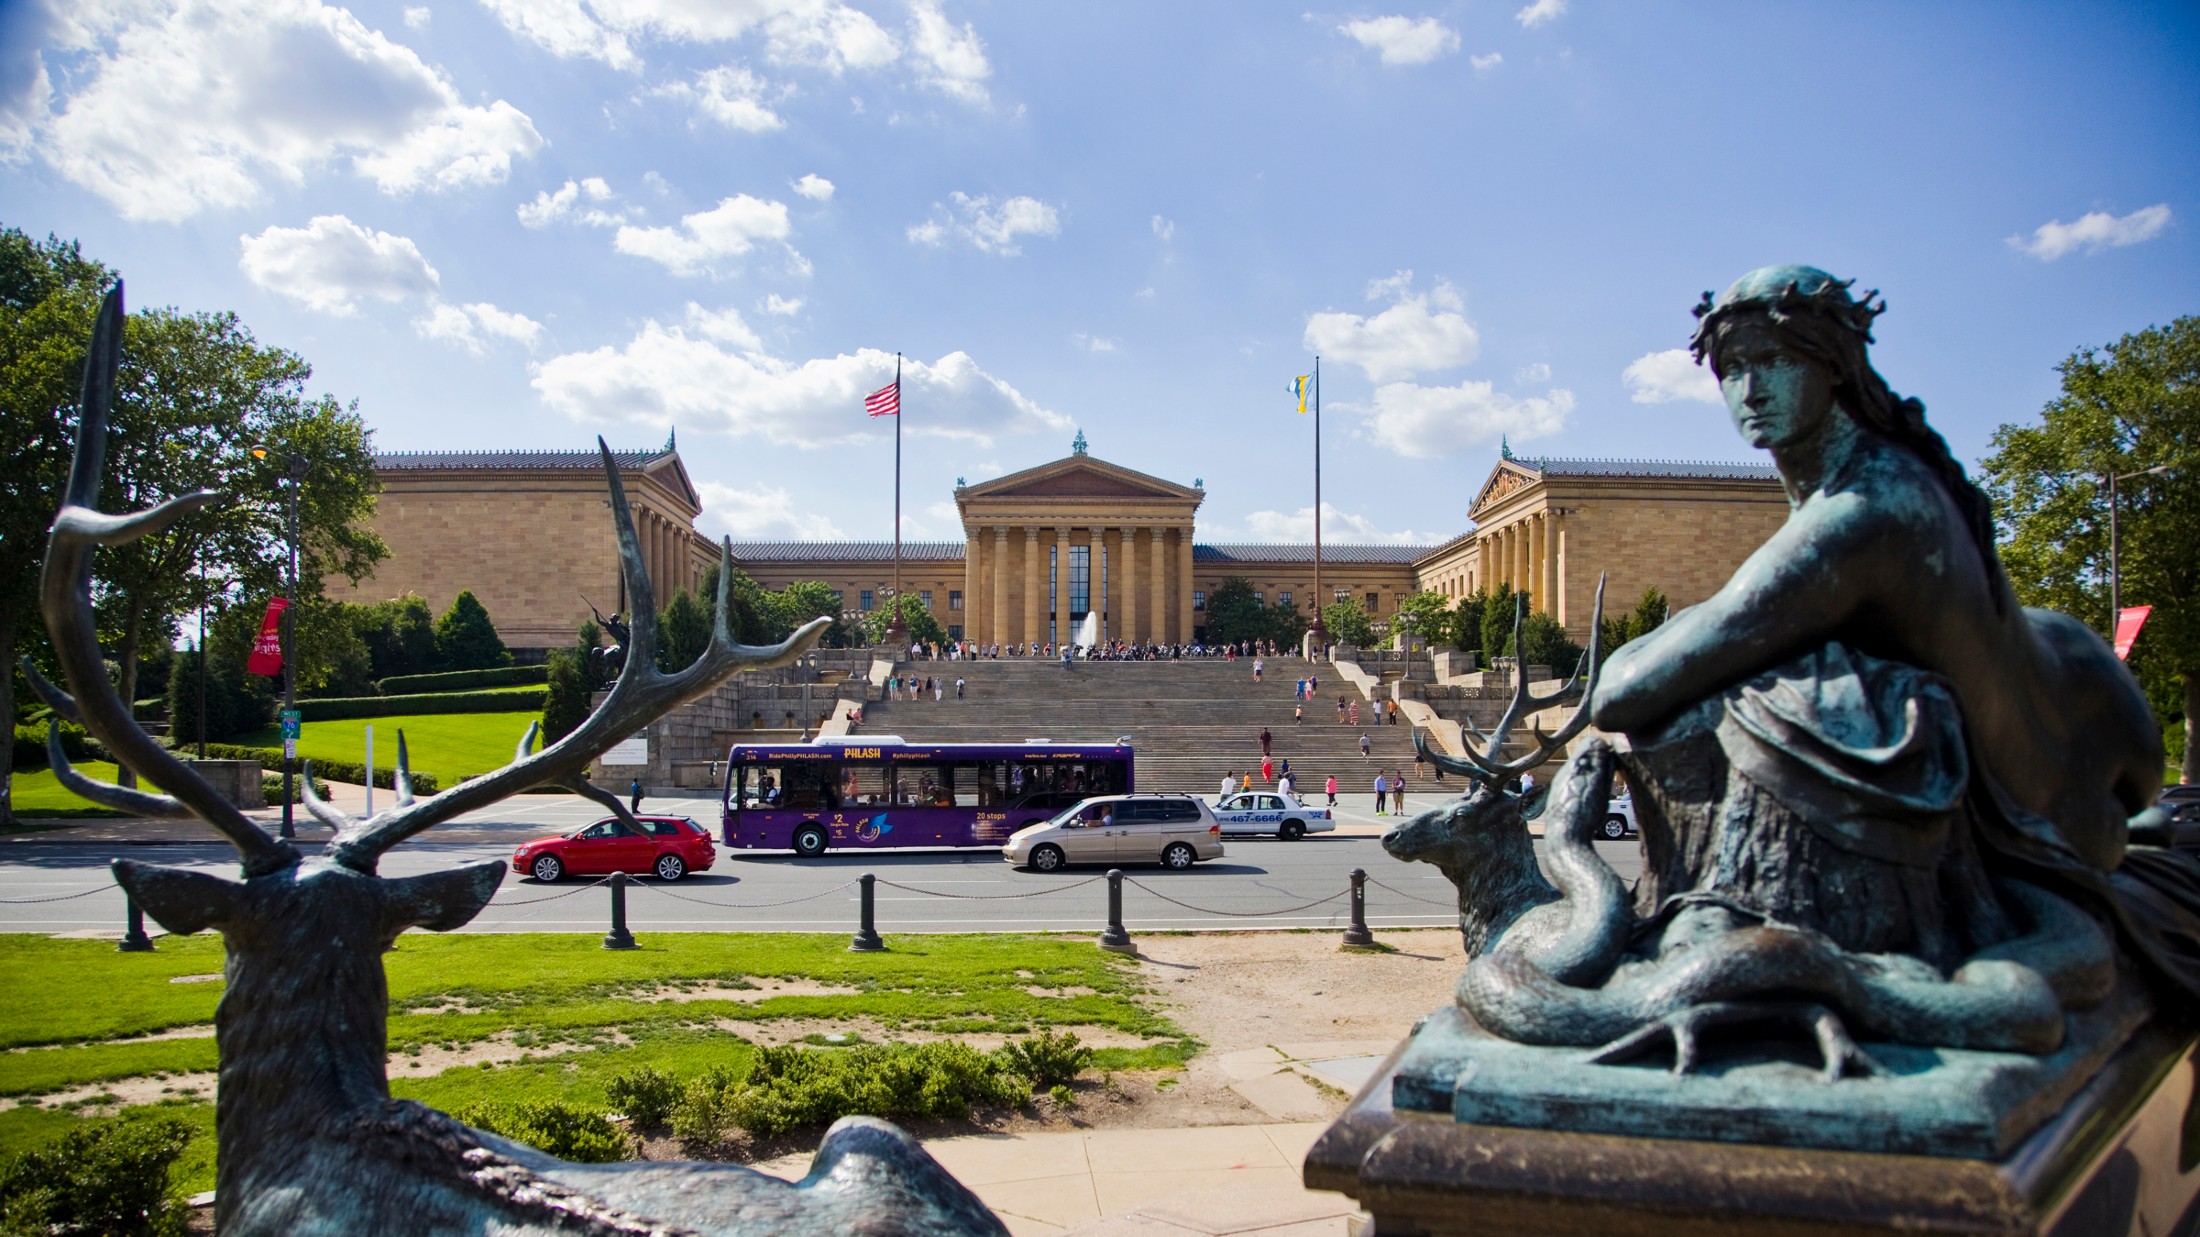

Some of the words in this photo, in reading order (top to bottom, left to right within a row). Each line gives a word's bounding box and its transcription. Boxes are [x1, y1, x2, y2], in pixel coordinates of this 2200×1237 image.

[287, 721, 296, 729] 76
[844, 747, 881, 759] PHLASH
[892, 752, 931, 760] #phillyphlash
[834, 813, 843, 823] $2
[976, 812, 986, 820] 20
[986, 812, 1006, 821] stops
[1230, 814, 1283, 823] 467-6666
